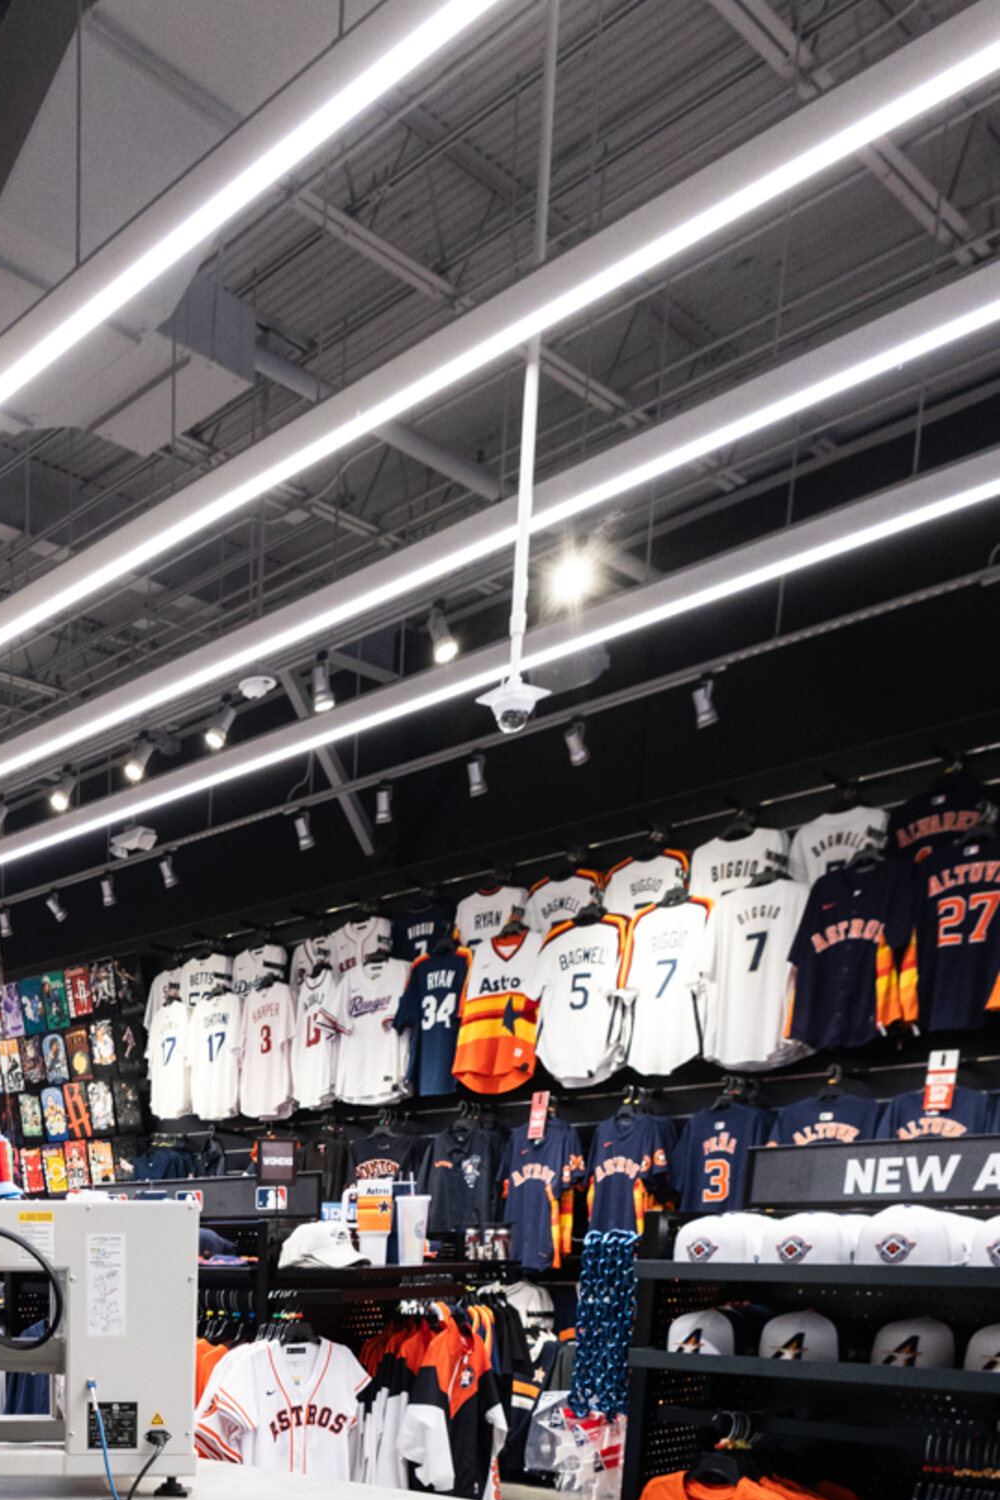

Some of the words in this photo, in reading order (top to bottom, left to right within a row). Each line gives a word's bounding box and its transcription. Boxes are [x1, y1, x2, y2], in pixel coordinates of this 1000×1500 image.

[711, 860, 759, 883] BIGGIO
[928, 861, 1000, 897] ALTUV
[474, 911, 502, 930] RYAN
[937, 890, 1000, 948] 27
[746, 931, 768, 972] 7
[427, 969, 456, 991] RYAN
[569, 972, 592, 1010] 5
[656, 959, 678, 999] 7
[421, 993, 457, 1030] 34
[207, 1032, 226, 1062] 17
[260, 1025, 273, 1054] 3
[702, 1158, 730, 1202] 3
[843, 1154, 962, 1195] NEW
